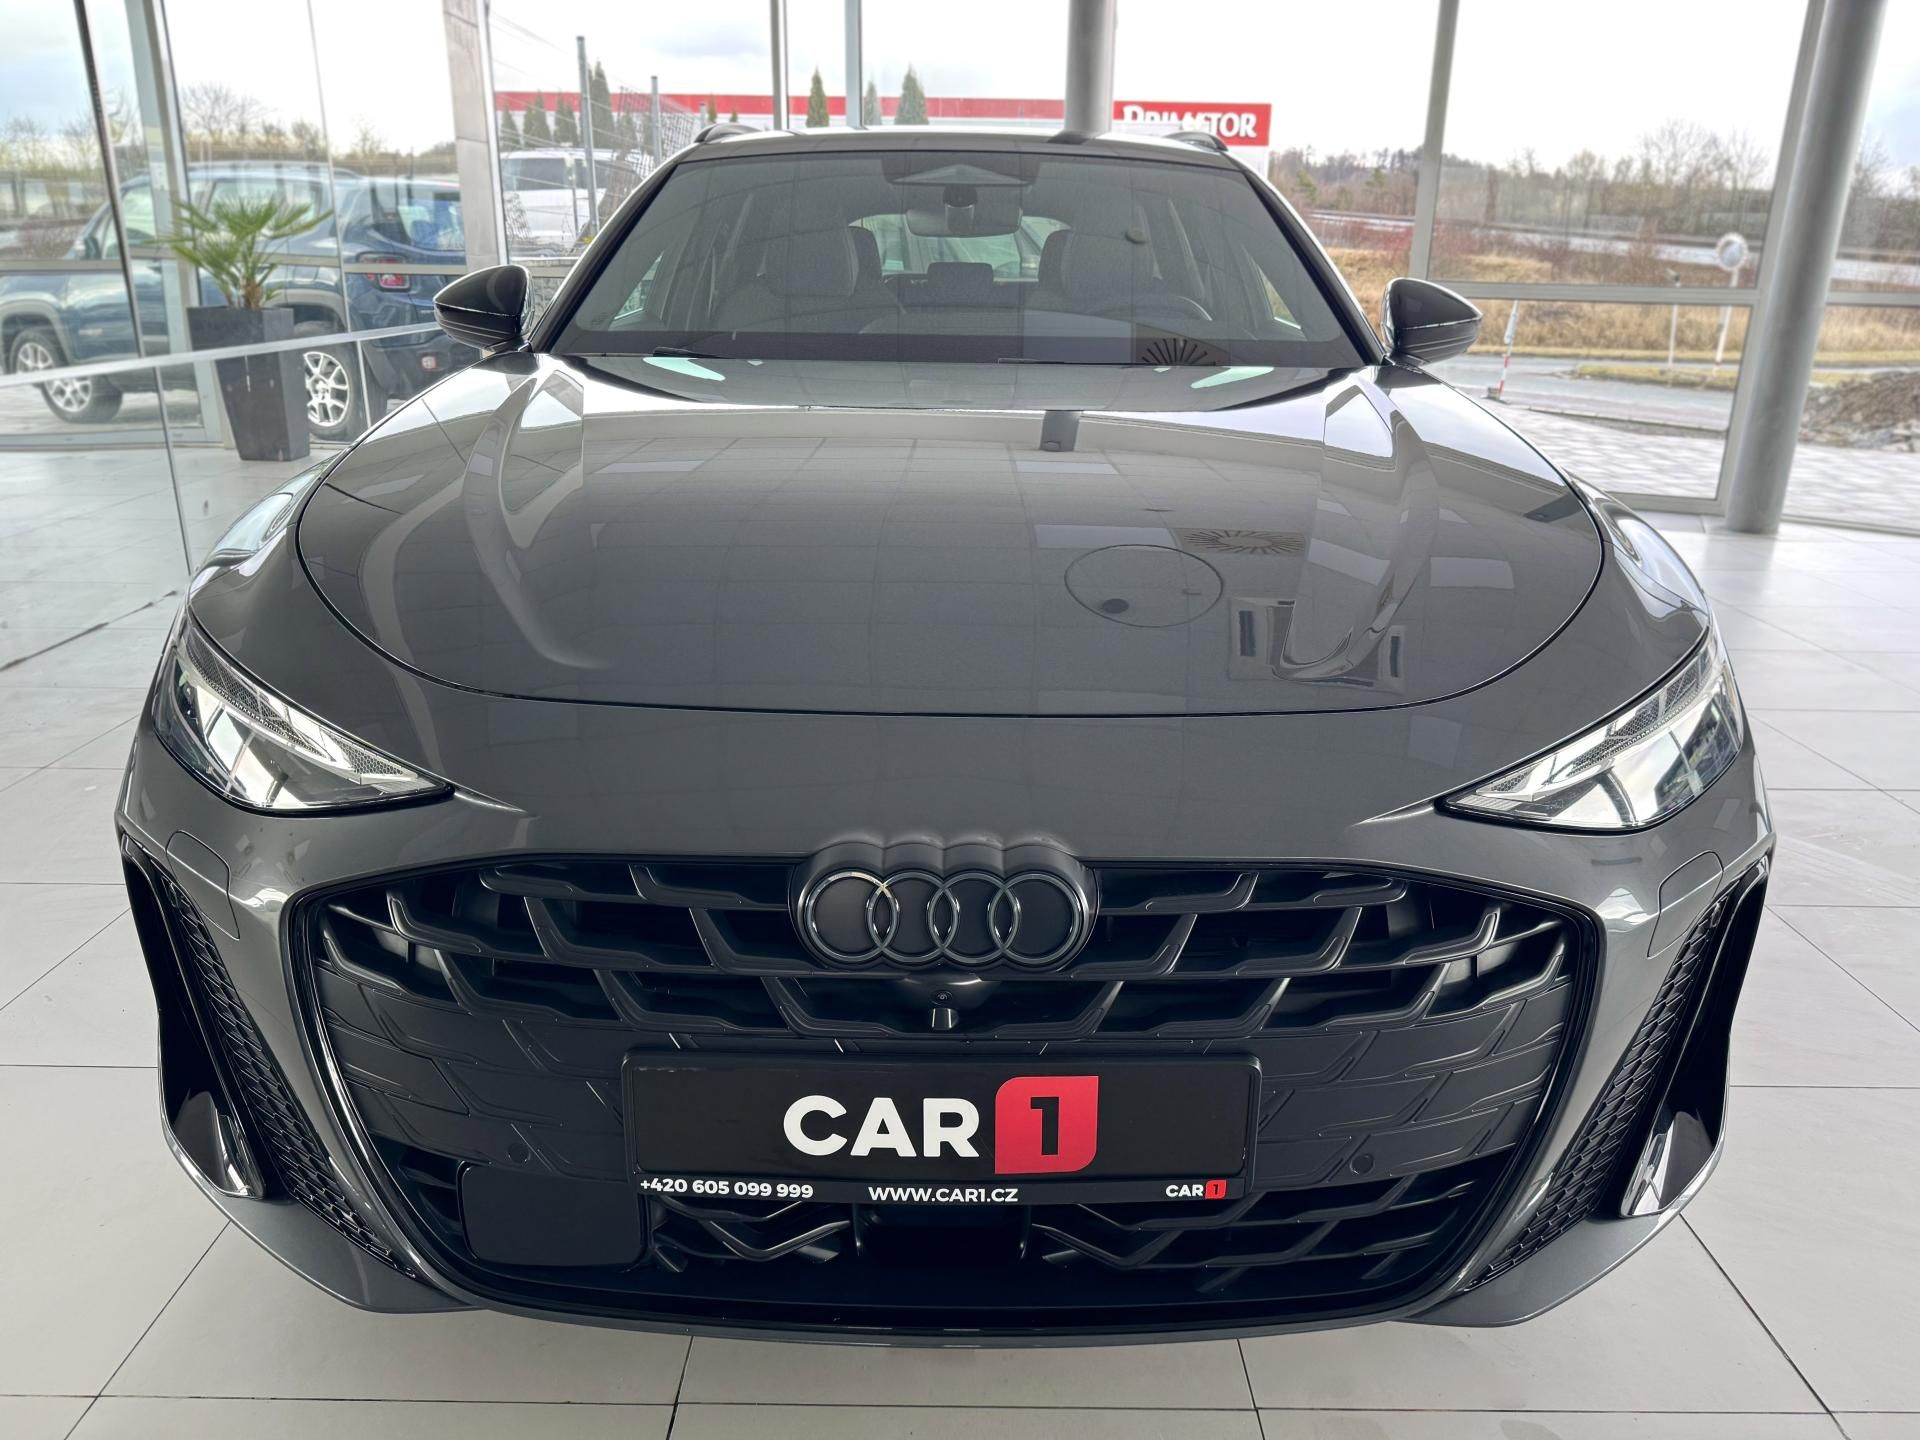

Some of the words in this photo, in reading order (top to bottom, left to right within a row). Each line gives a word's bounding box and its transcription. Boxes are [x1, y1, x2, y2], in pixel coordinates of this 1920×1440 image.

[640, 1178, 688, 1193] +420
[692, 1180, 730, 1195] 605
[734, 1181, 773, 1196] 099
[776, 1183, 814, 1199] 999
[868, 1186, 1019, 1203] WWW.CAR1.CZ
